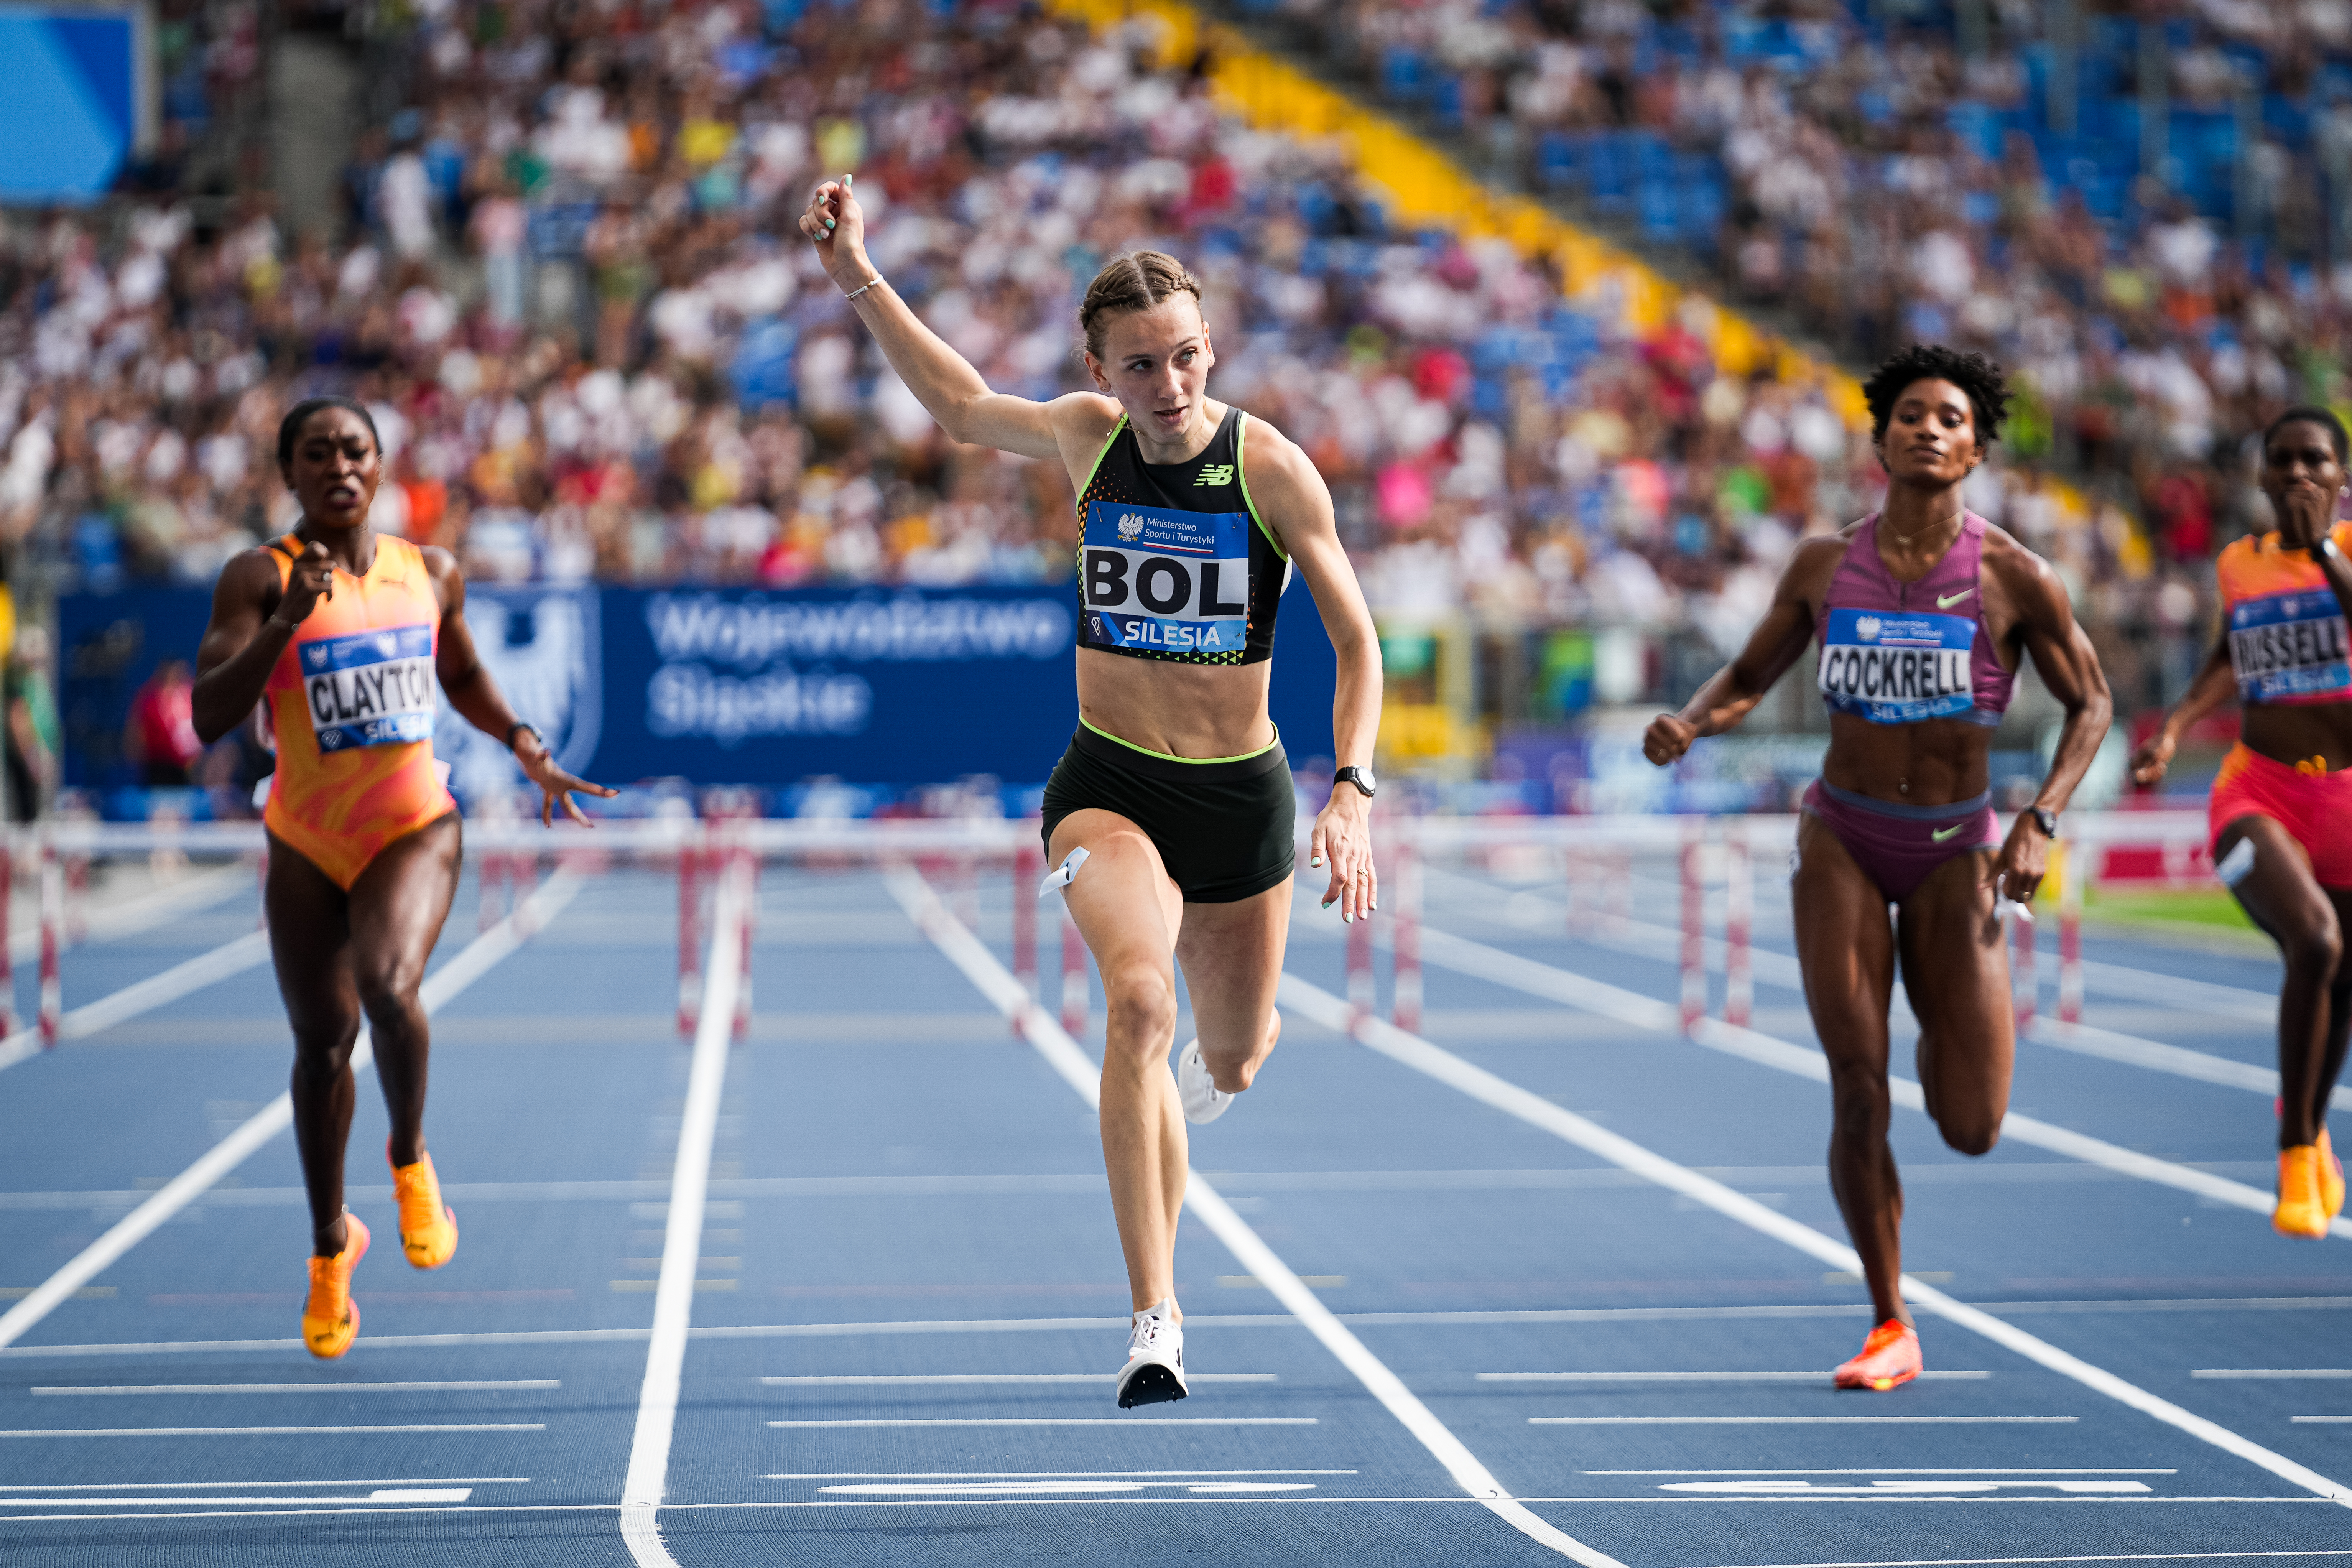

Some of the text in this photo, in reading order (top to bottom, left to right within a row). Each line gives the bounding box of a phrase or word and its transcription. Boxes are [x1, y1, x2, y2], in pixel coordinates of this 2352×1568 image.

[1193, 464, 1234, 486] NB
[1147, 517, 1197, 531] Ministerstwo
[1144, 528, 1214, 545] Sportu i Turystyki
[1086, 549, 1245, 617] BOL
[1125, 621, 1222, 647] SILESIA
[1826, 647, 1967, 697] COCKRELL
